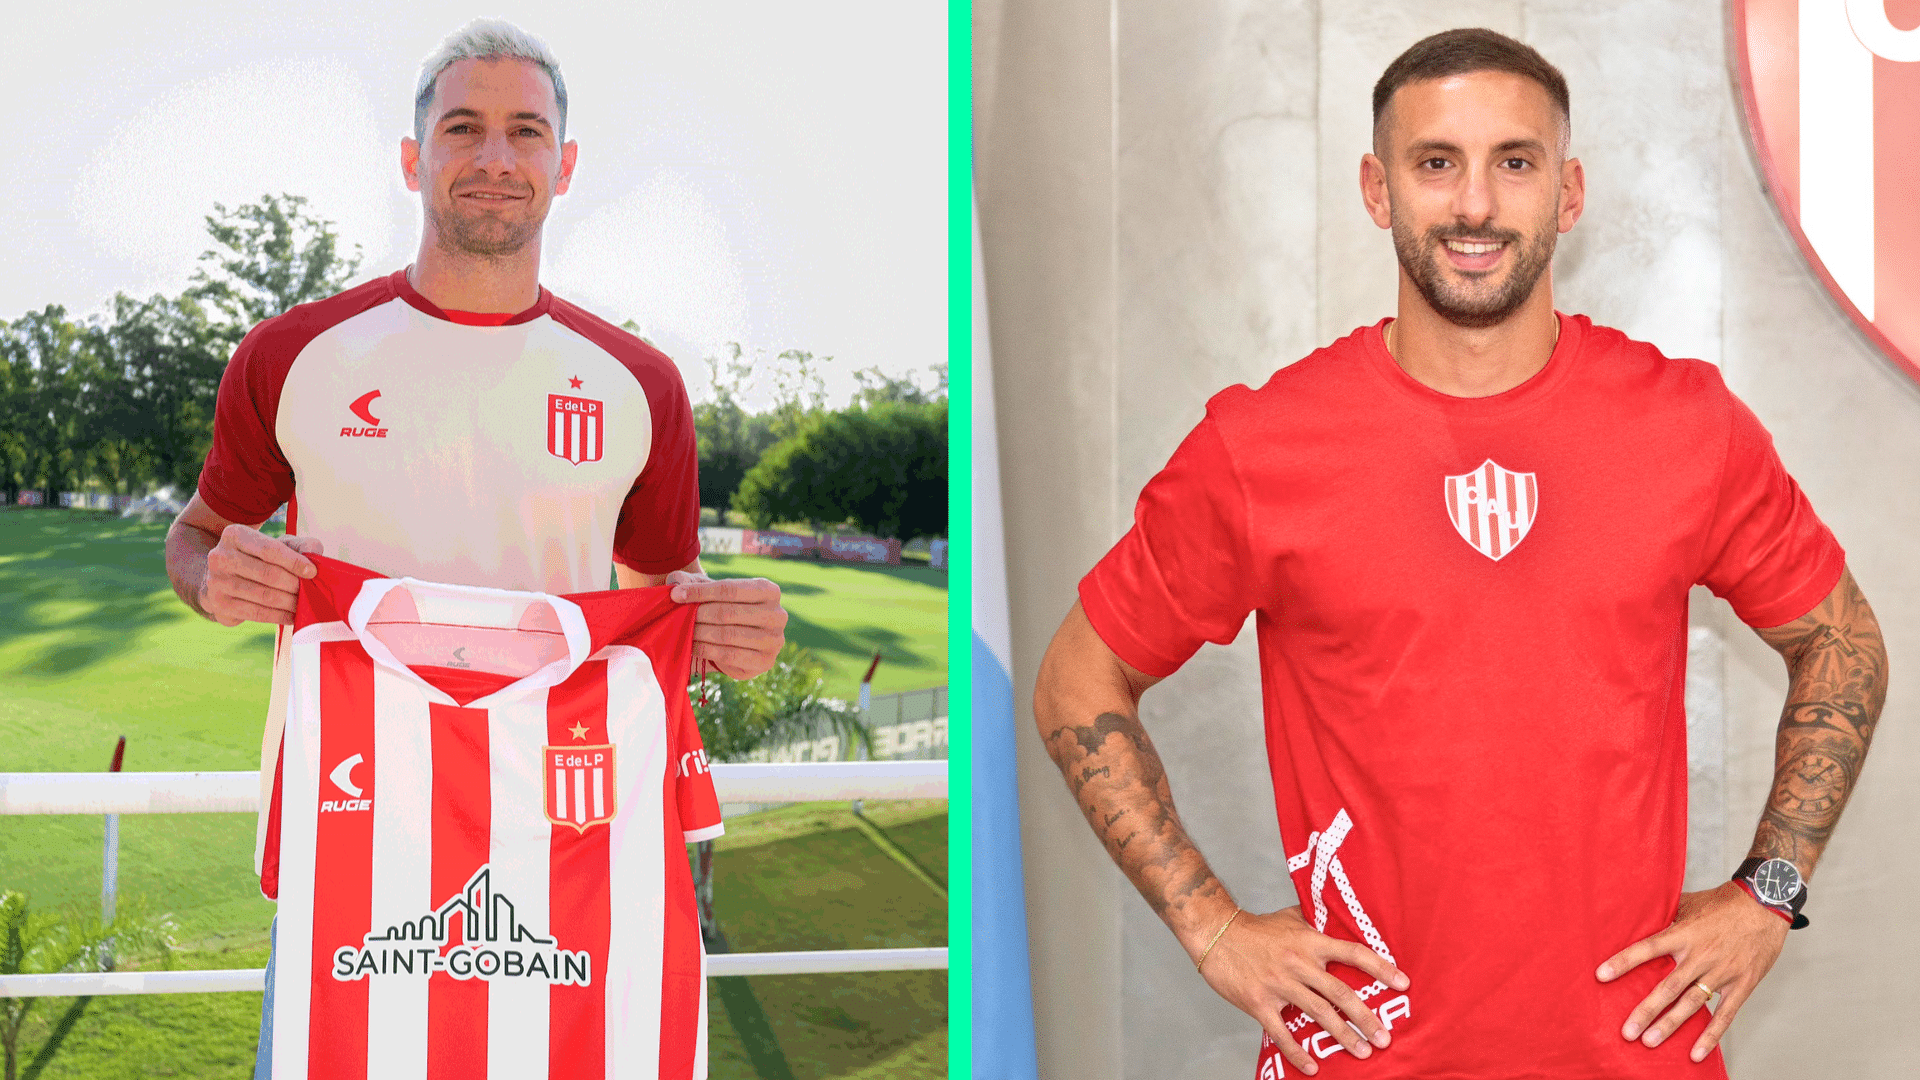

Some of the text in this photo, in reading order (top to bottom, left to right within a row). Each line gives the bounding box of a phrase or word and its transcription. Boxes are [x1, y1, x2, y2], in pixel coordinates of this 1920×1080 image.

[340, 426, 389, 438] RUGE
[1463, 485, 1523, 530] CAU
[320, 799, 373, 813] RUGE
[336, 948, 588, 982] SAINT-GOBAIN
